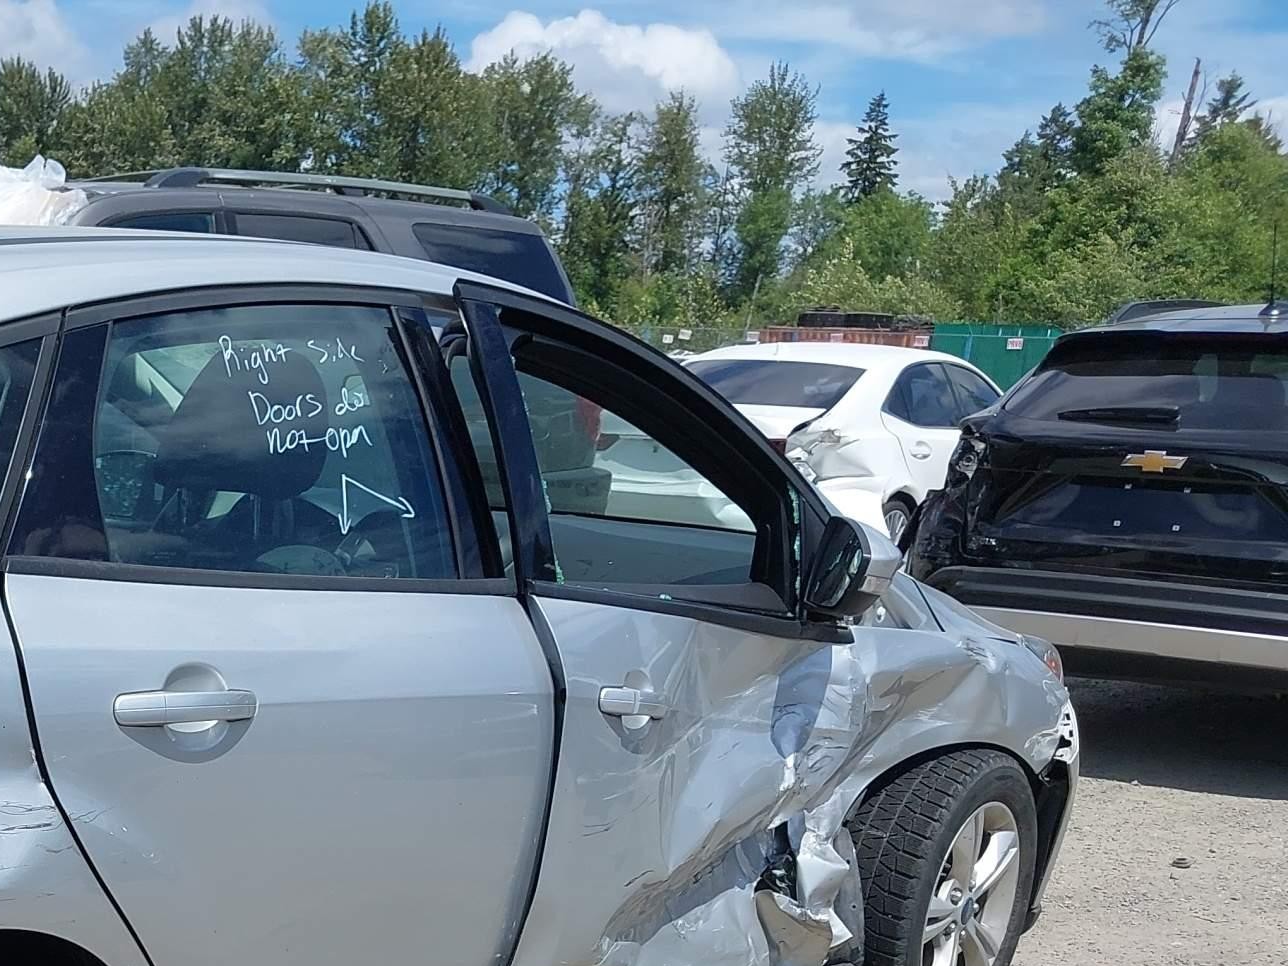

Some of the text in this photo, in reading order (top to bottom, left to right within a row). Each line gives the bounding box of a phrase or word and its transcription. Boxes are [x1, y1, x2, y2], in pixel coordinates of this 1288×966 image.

[218, 335, 365, 385] Right Side
[248, 391, 323, 426] Doors
[266, 427, 326, 454] not
